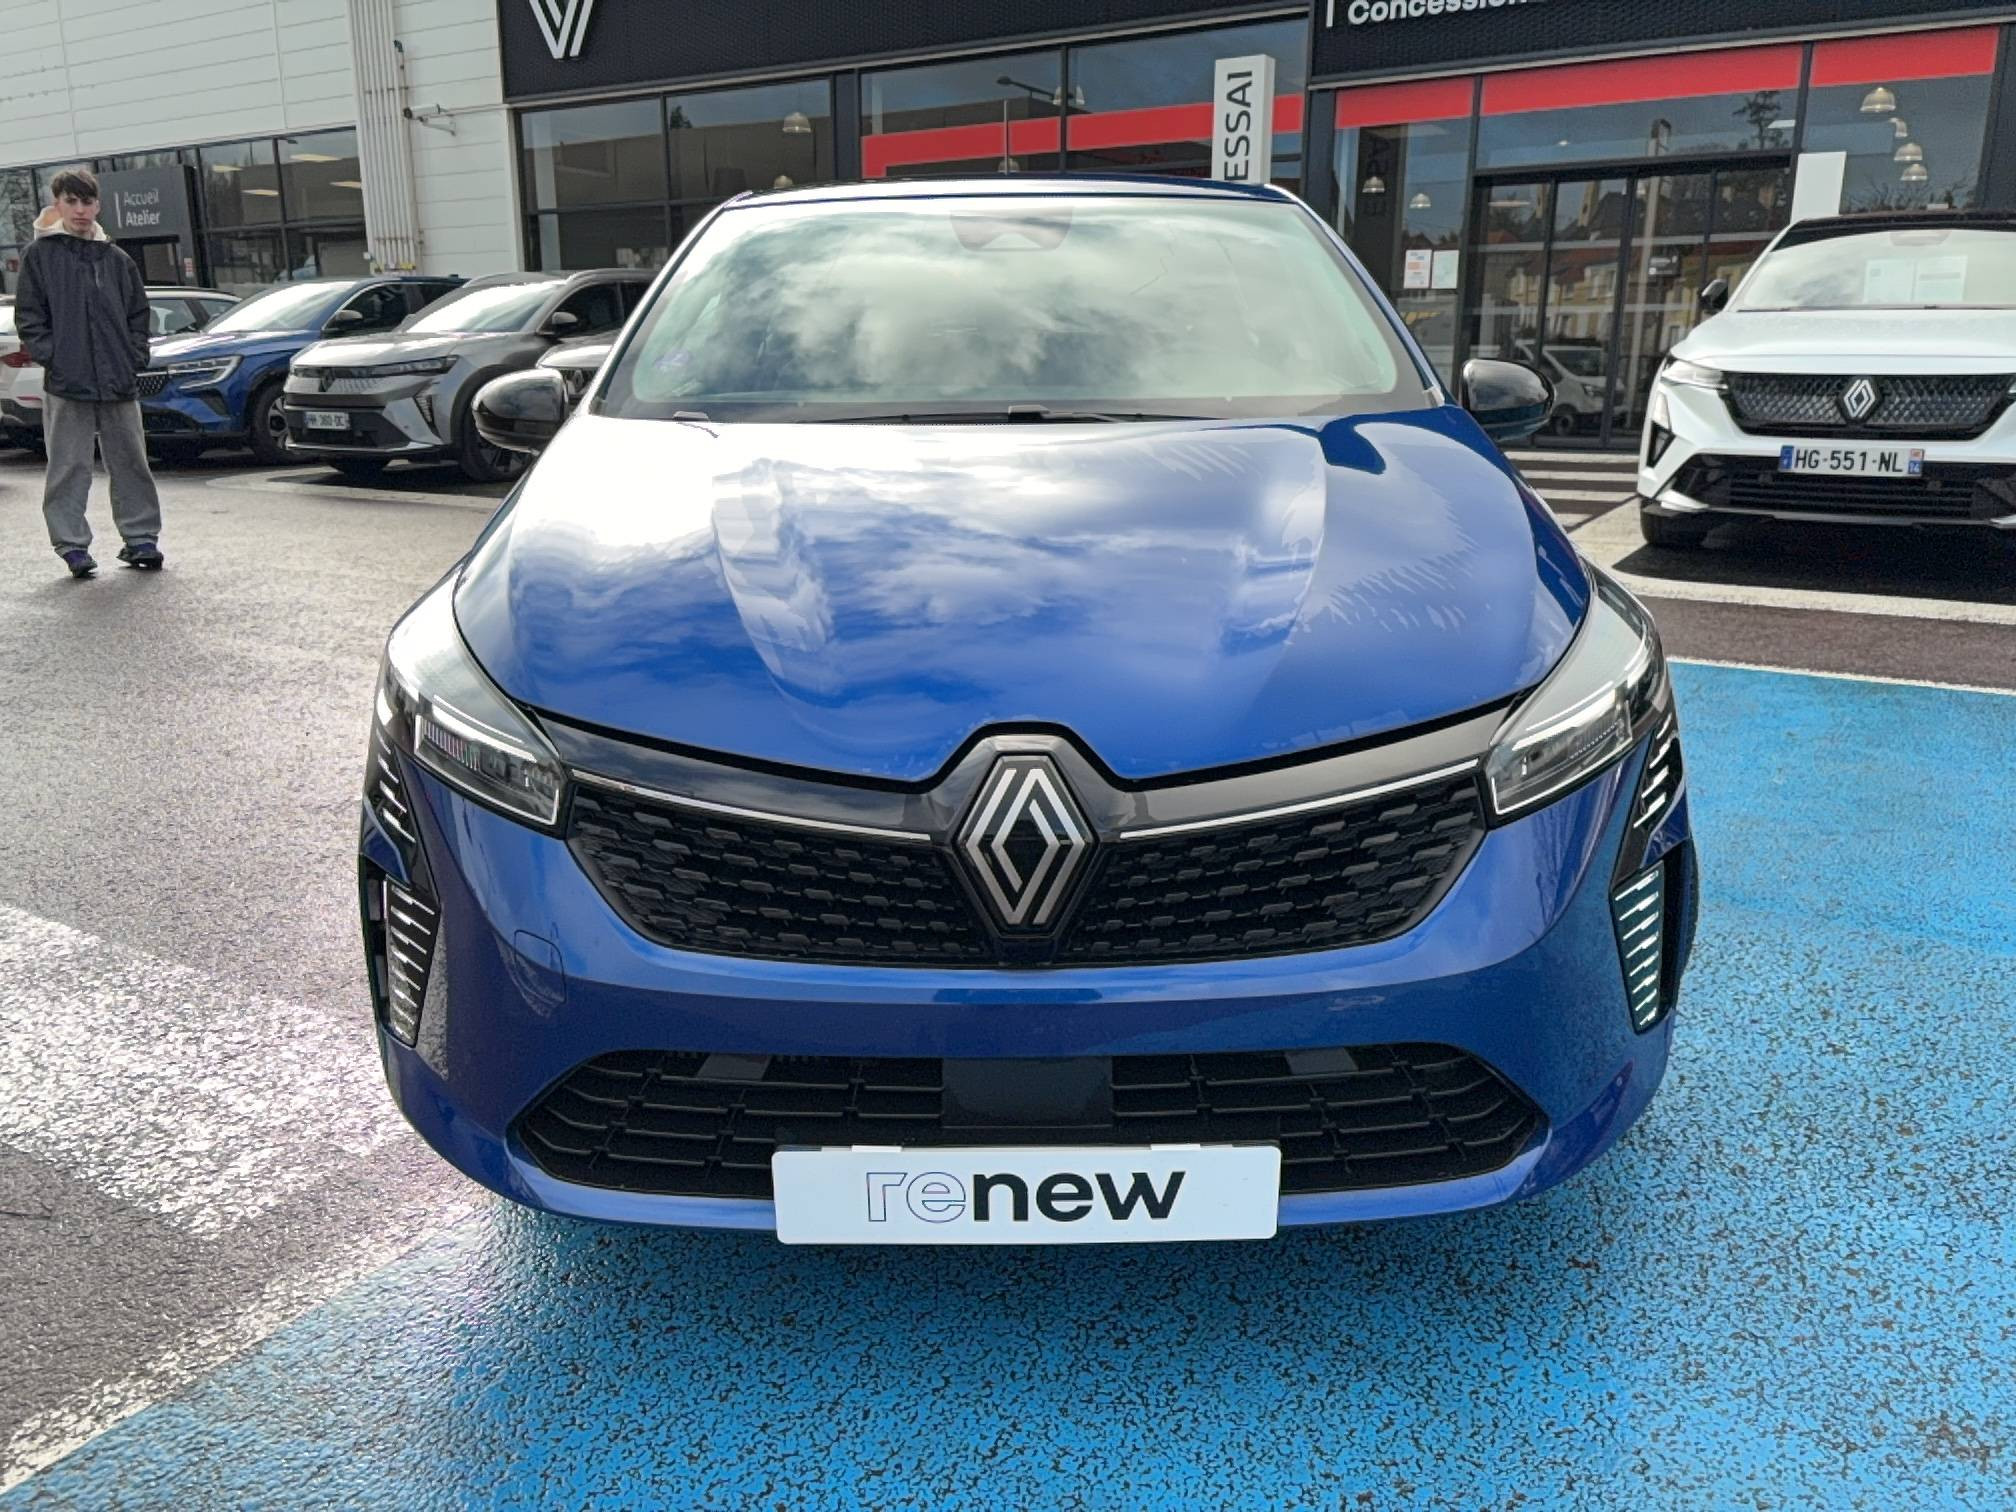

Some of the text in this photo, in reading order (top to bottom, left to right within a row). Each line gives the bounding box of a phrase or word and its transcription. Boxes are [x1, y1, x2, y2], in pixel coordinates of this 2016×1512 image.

[1224, 70, 1252, 181] ESSAI
[124, 188, 159, 206] Accueil
[125, 209, 160, 227] Atelier
[1794, 449, 1903, 473] HG-551-NL
[866, 1171, 1186, 1223] renew
